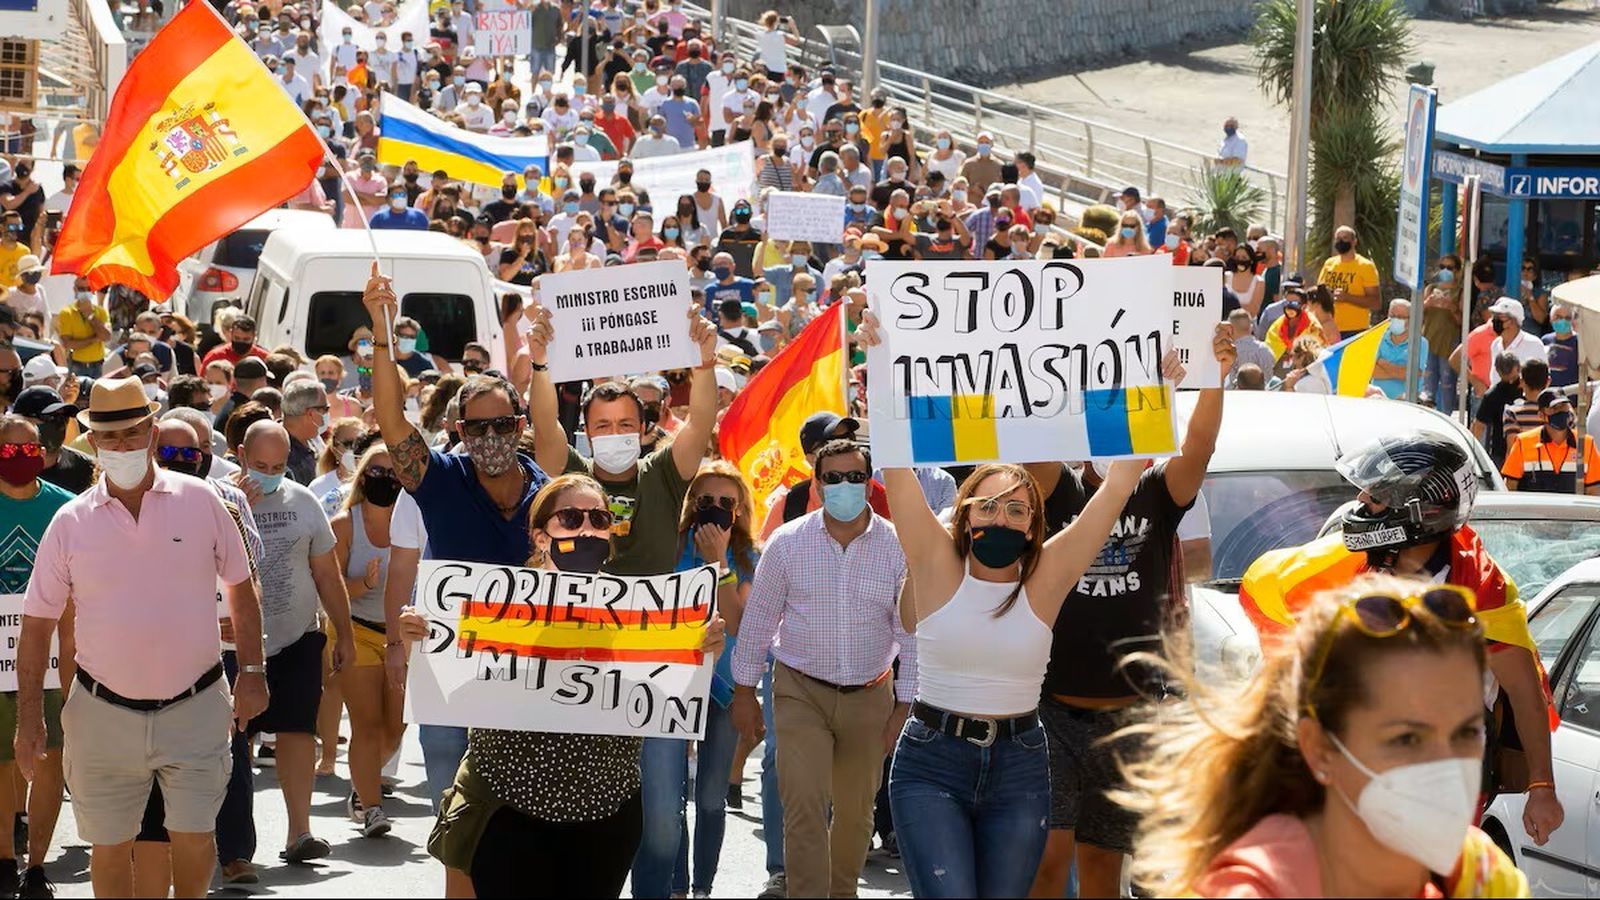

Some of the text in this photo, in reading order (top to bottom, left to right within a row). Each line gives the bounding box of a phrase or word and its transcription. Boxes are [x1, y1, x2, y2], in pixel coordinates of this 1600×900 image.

[488, 34, 518, 54] ¡YA!
[1536, 176, 1600, 195] INFOR
[1325, 271, 1356, 284] CRAZY
[556, 280, 678, 309] MINISTRO ESCRIVÁ
[890, 262, 1085, 333] STOP
[1173, 289, 1205, 308] RIVÁ
[600, 309, 658, 330] PÓNGASE
[575, 334, 671, 358] A TRABAJAR !!!
[893, 308, 1168, 420] INVASIÓN
[1076, 571, 1141, 597] EANS
[424, 564, 717, 631] GOBIERNO
[420, 620, 703, 734] DIMISIÓN
